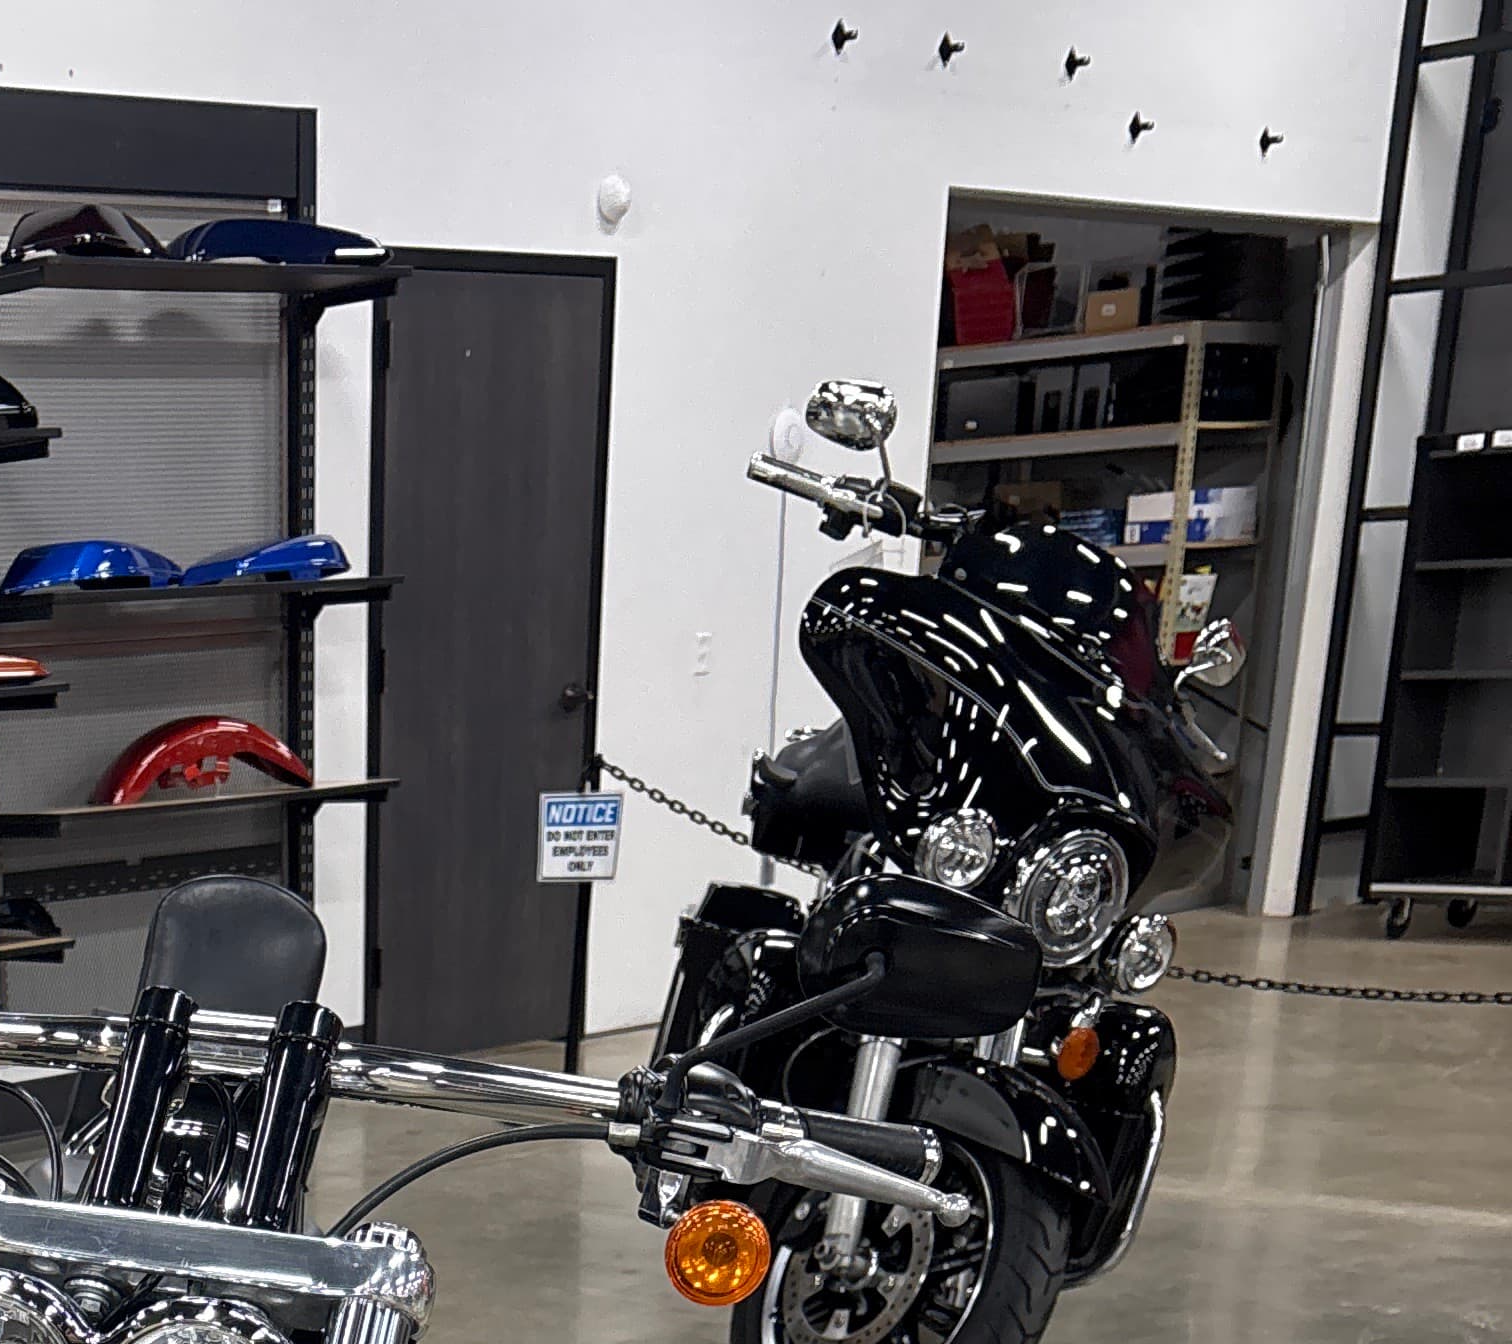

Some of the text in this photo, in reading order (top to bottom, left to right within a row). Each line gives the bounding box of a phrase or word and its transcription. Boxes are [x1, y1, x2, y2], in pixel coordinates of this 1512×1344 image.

[548, 803, 616, 823] NOTICE
[546, 830, 615, 842] DO NOT ENTER
[552, 846, 609, 856] EMPLOYEES
[567, 861, 594, 872] ONLY
